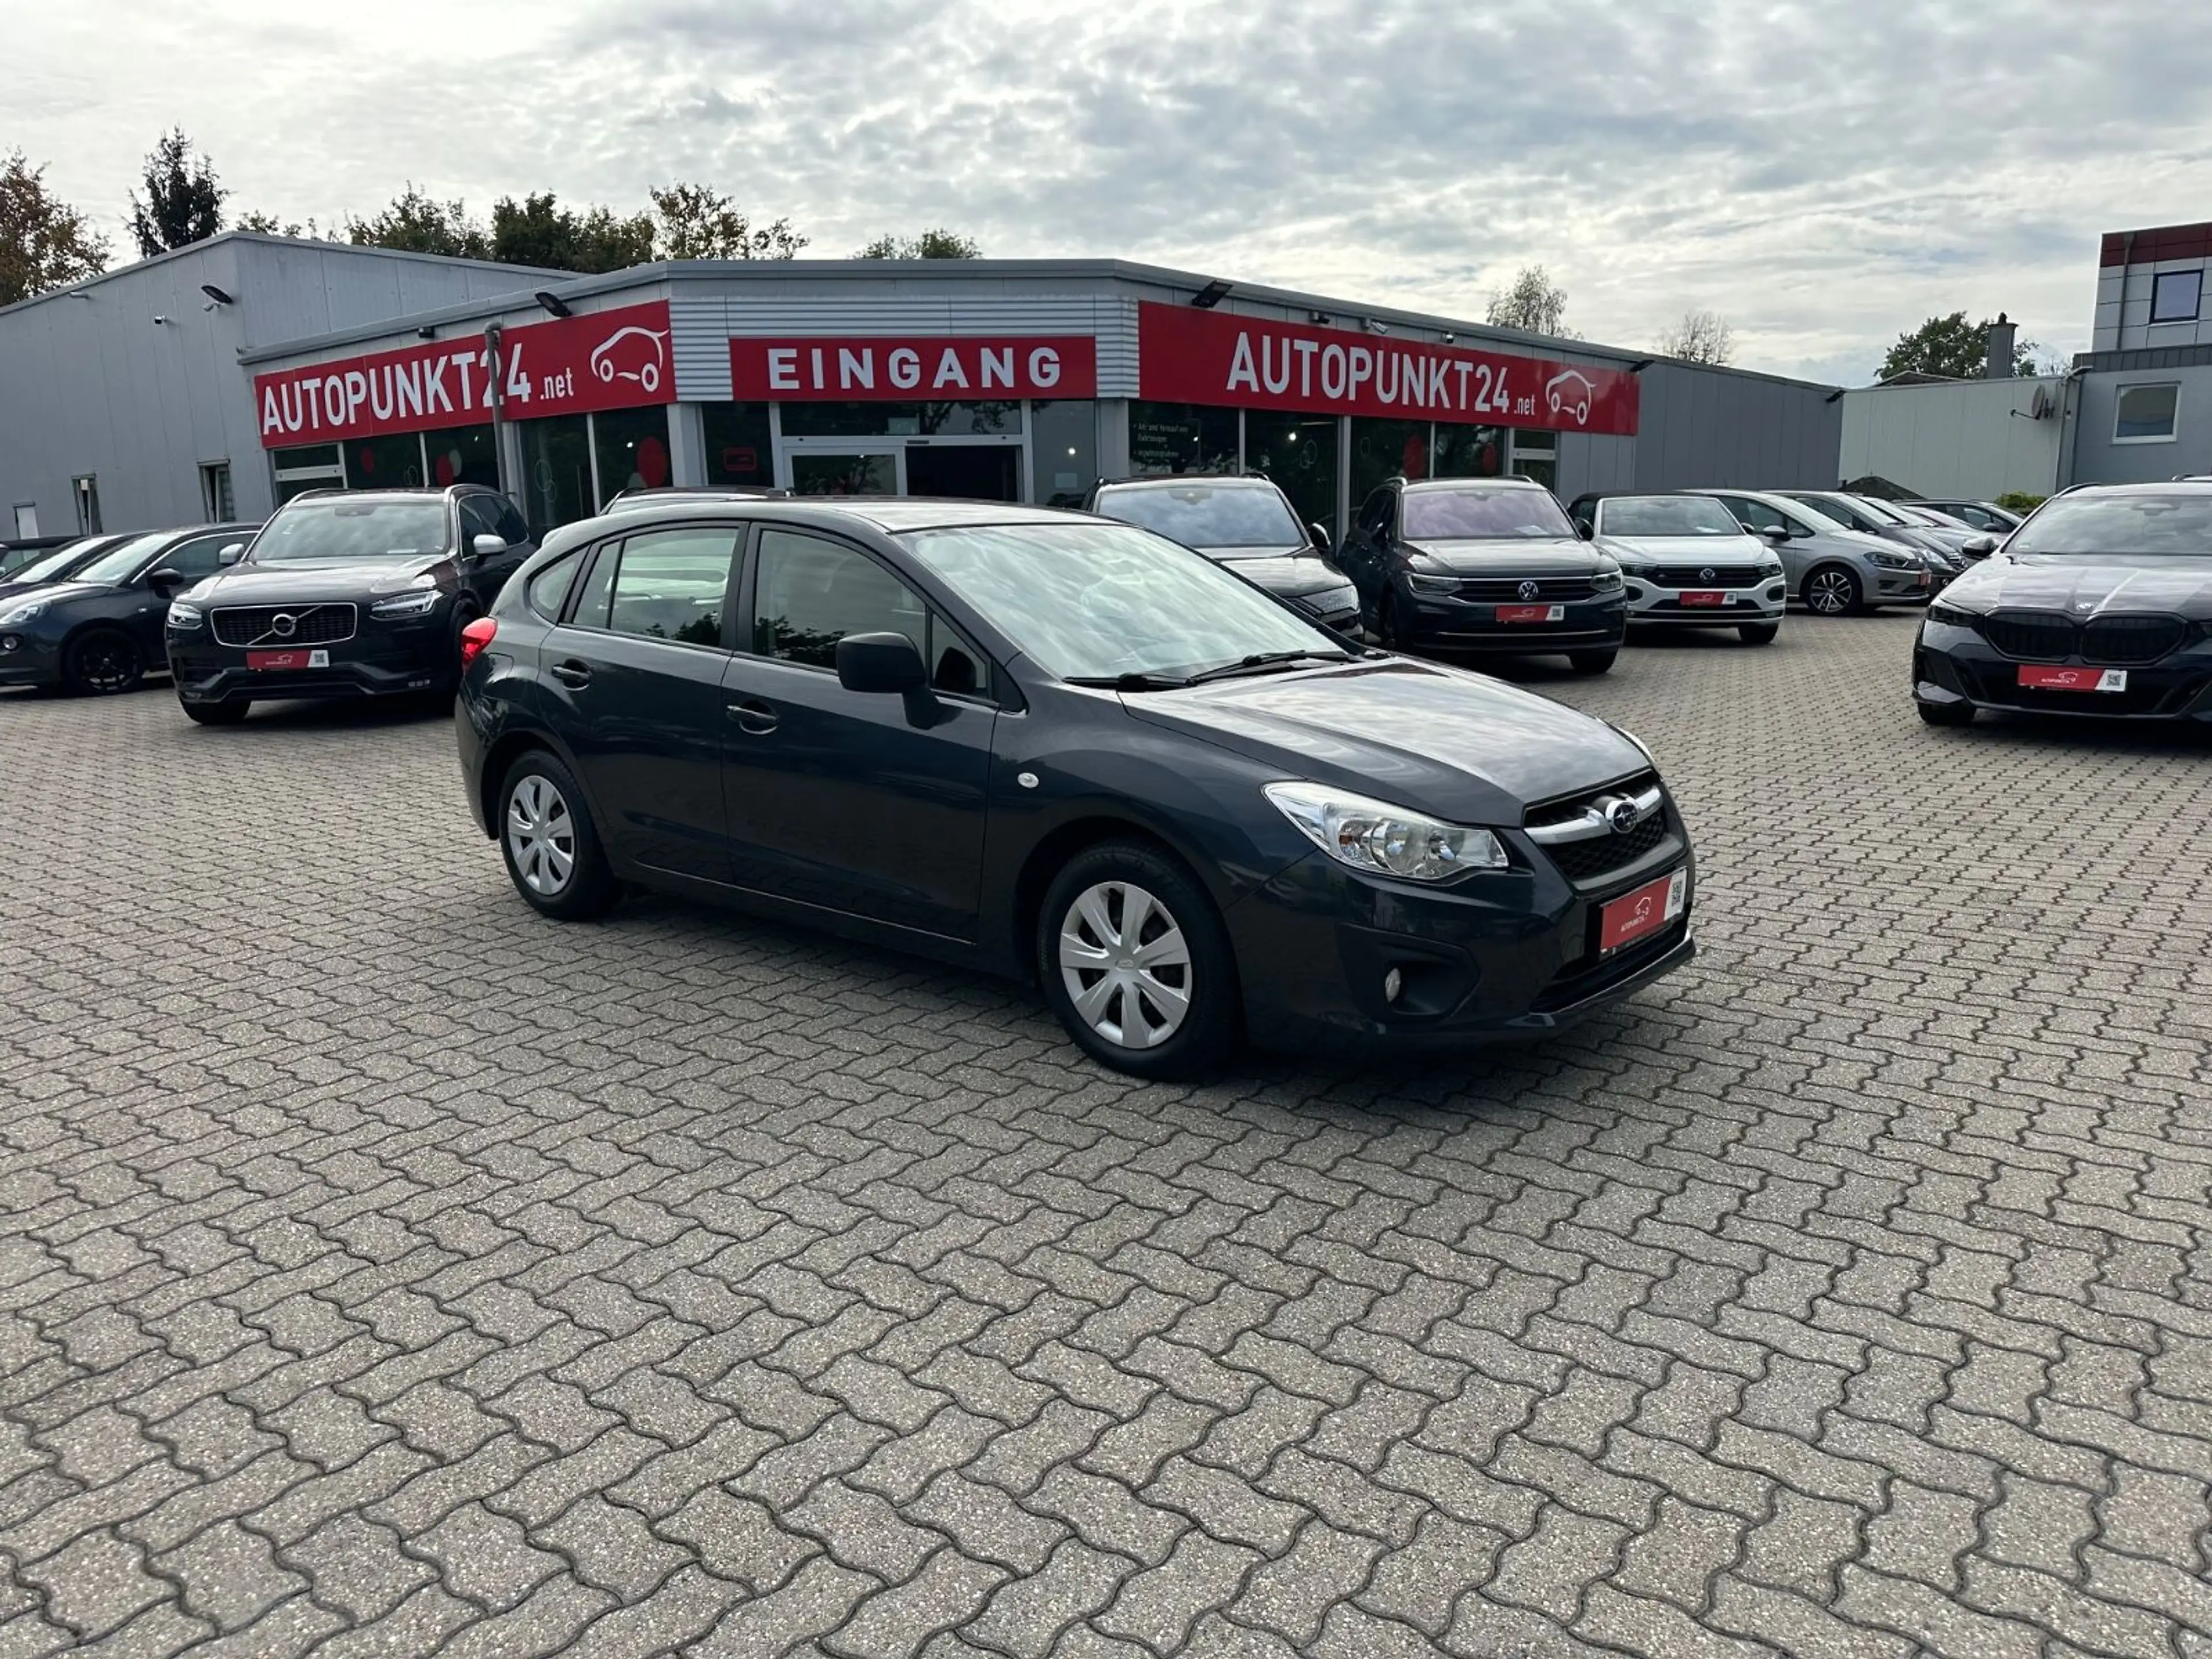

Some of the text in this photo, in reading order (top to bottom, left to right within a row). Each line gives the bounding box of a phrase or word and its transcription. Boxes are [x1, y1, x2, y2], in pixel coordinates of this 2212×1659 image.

[263, 343, 574, 435] AUTOPUNKT24 .net
[768, 347, 1060, 389] EINGANG
[1226, 332, 1536, 416] AUTOPUNKT24 .net
